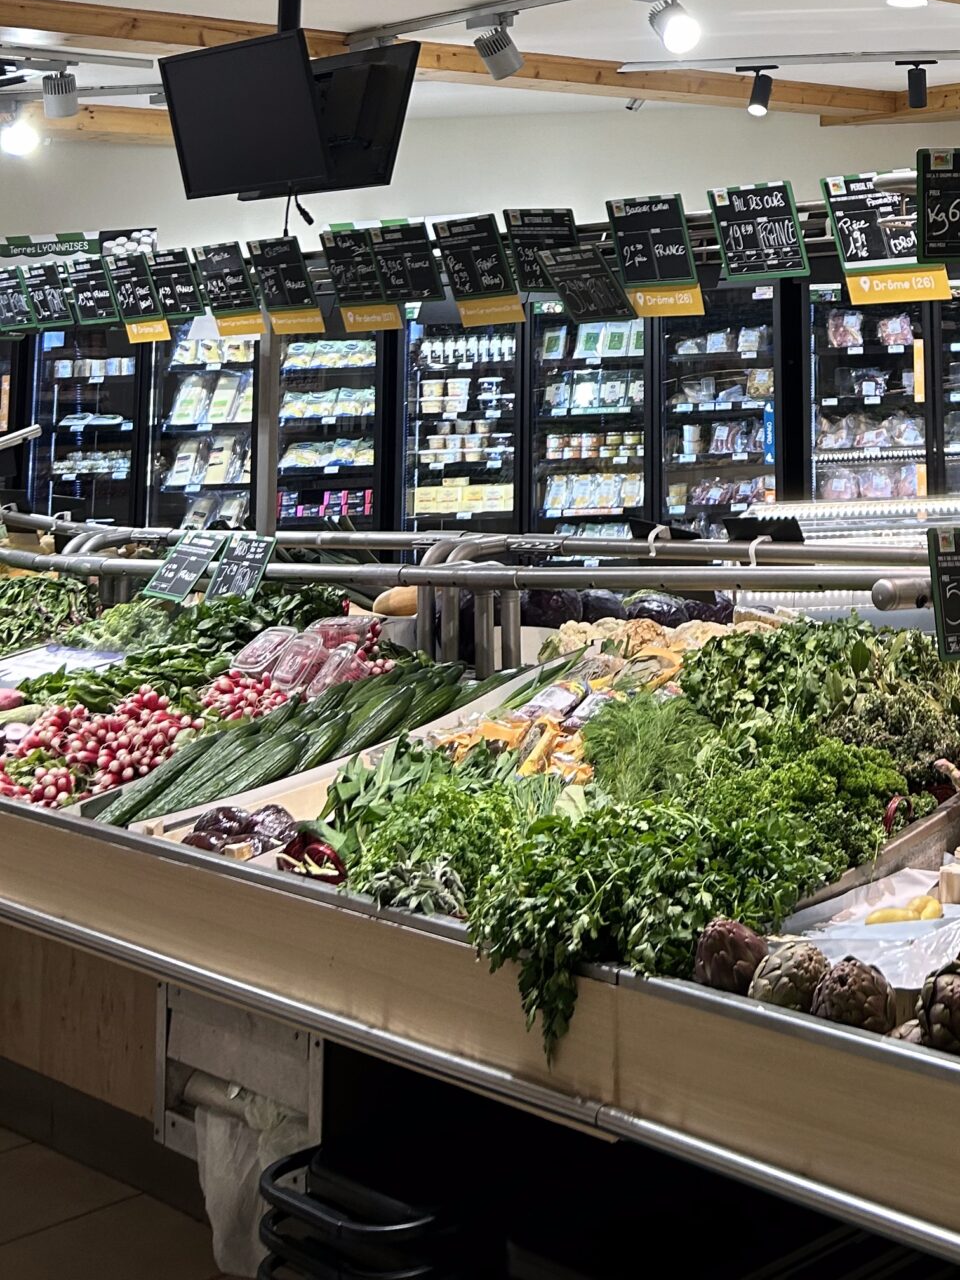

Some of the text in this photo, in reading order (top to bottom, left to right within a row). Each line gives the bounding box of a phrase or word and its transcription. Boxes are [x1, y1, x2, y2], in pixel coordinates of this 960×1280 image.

[732, 191, 785, 212] AIL DES OURS
[757, 219, 797, 250] FRANCE
[9, 241, 89, 254] Terres LYONNAISES
[654, 244, 686, 258] FRANCE
[873, 276, 935, 291] Drôme (26)
